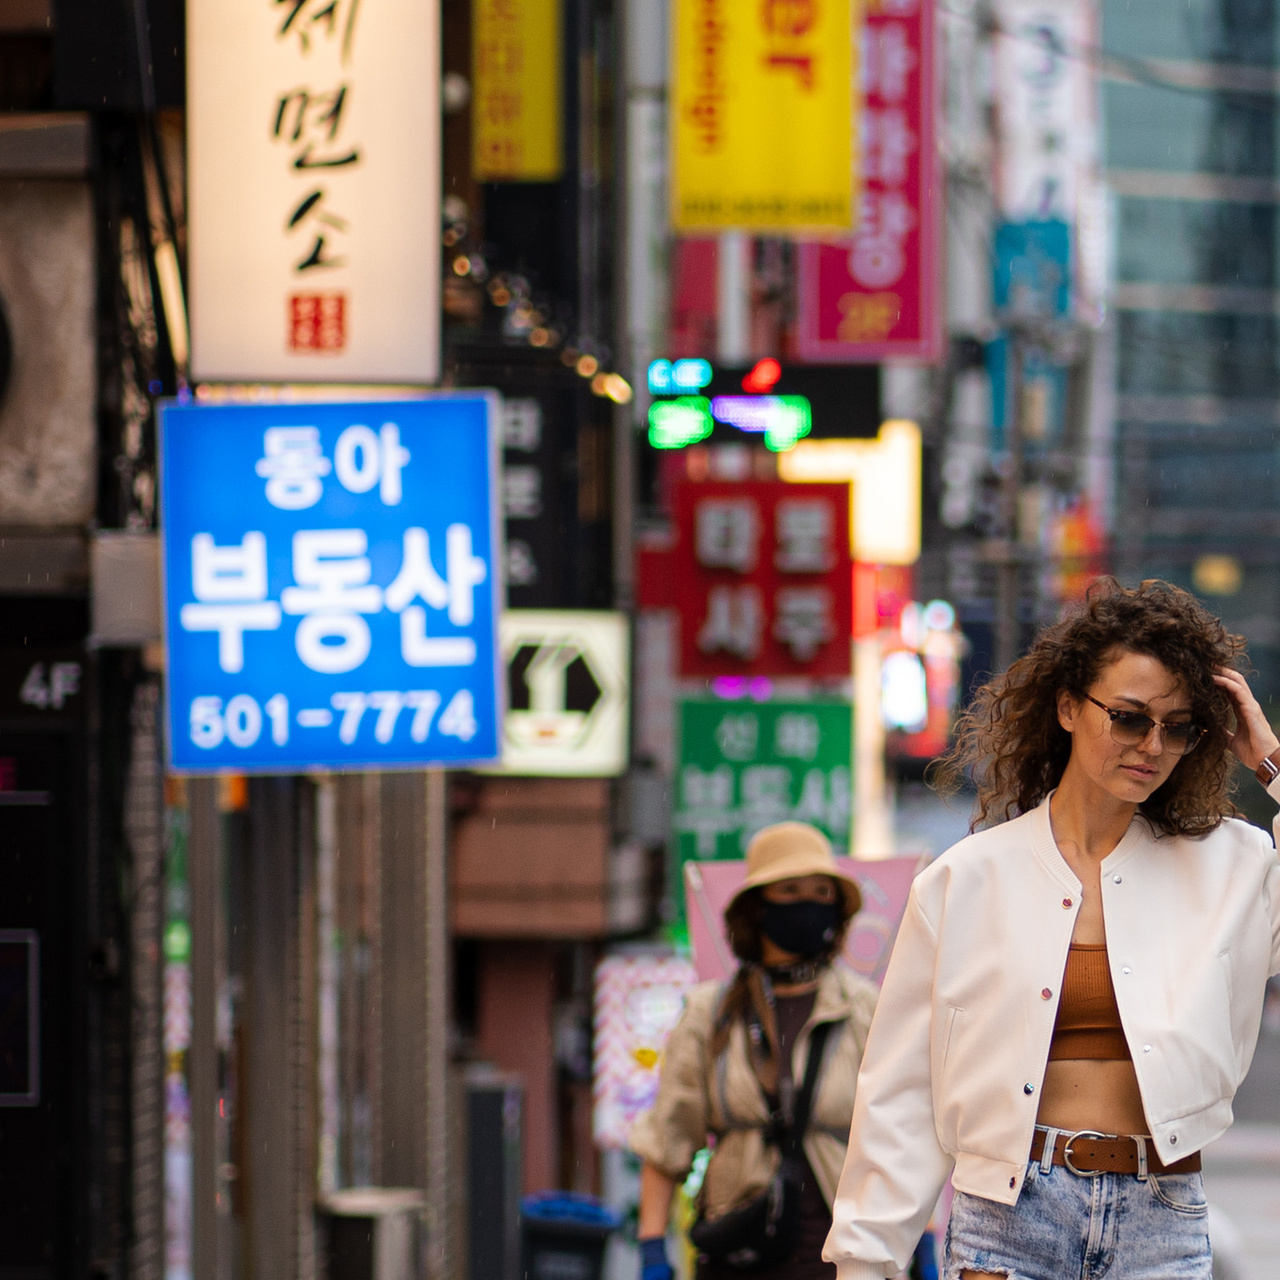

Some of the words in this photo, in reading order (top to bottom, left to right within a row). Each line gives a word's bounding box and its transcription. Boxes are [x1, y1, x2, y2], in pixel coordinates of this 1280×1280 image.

[254, 421, 411, 511] 동아
[180, 522, 487, 674] 부동산
[19, 661, 83, 711] 4F
[189, 688, 478, 749] 501-7774
